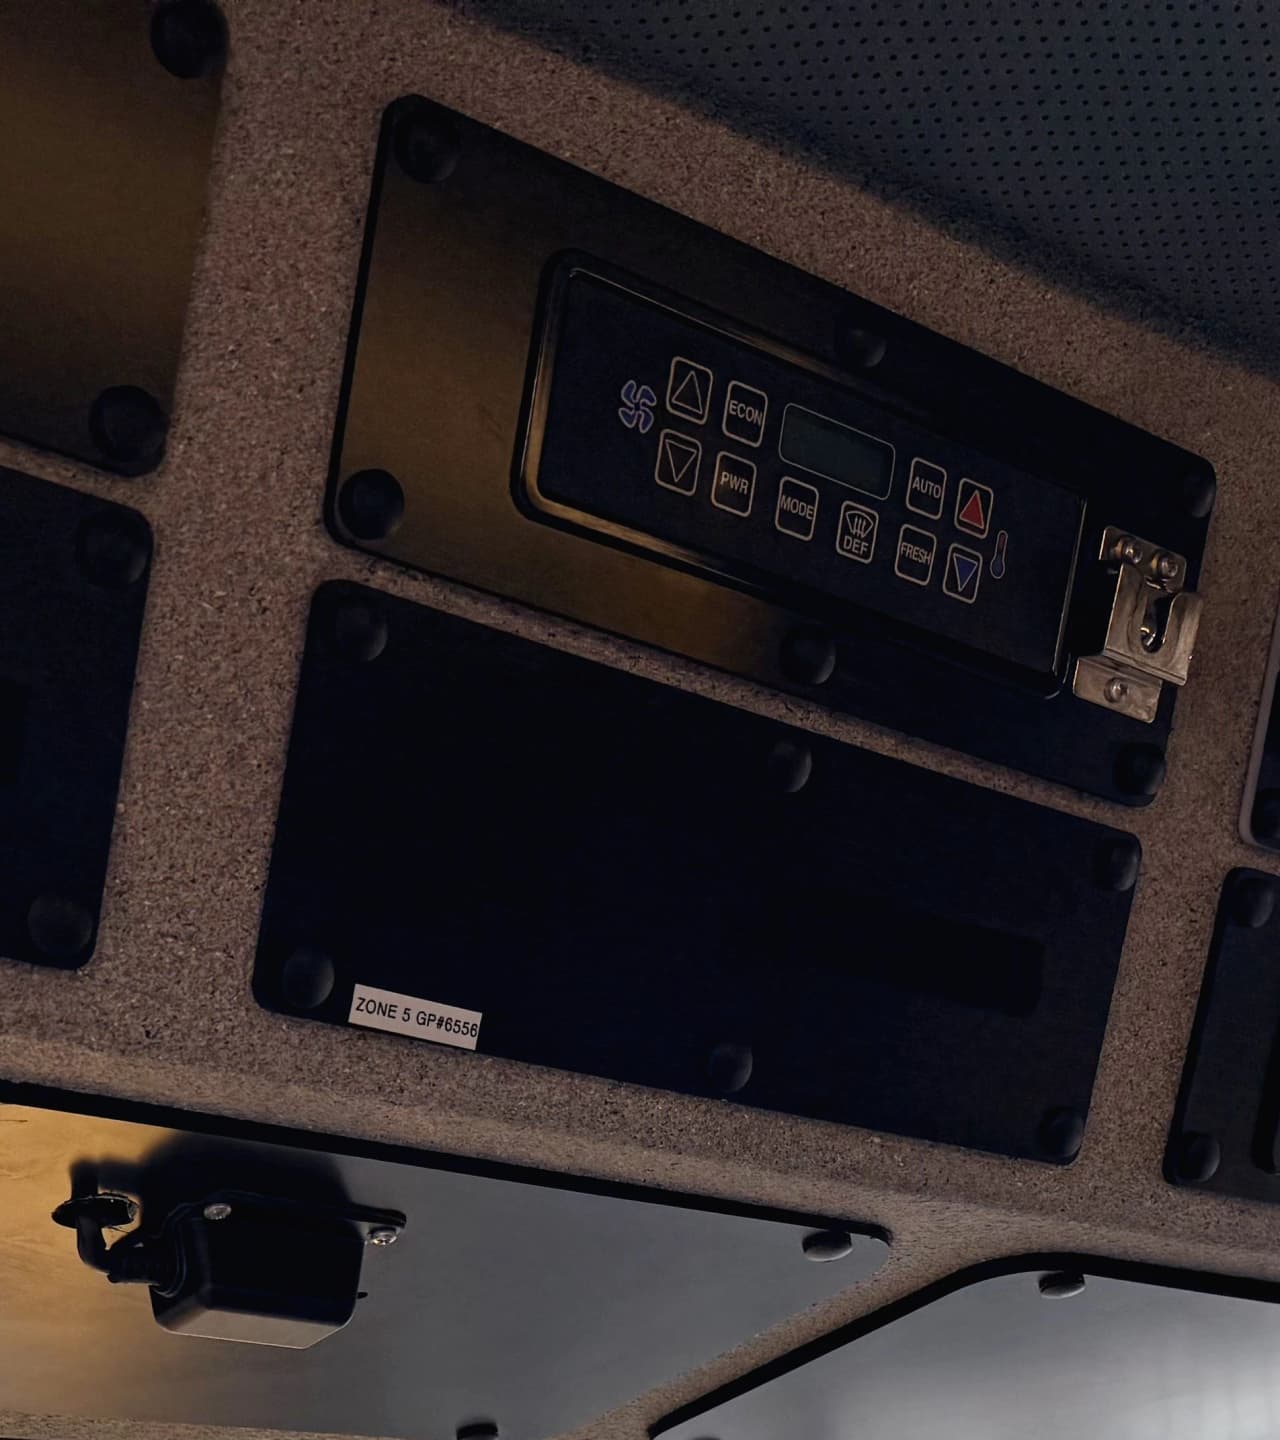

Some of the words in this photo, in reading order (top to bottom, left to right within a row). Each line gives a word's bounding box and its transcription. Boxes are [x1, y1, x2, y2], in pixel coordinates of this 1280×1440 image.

[728, 400, 763, 426] ECON
[720, 471, 749, 495] PWR
[912, 476, 941, 499] AUTO
[780, 494, 815, 520] MODE
[843, 535, 869, 556] DEF
[901, 542, 931, 565] FRESH
[355, 997, 398, 1019] ZONE
[401, 1008, 411, 1022] 5
[416, 1011, 478, 1038] GP#6556
